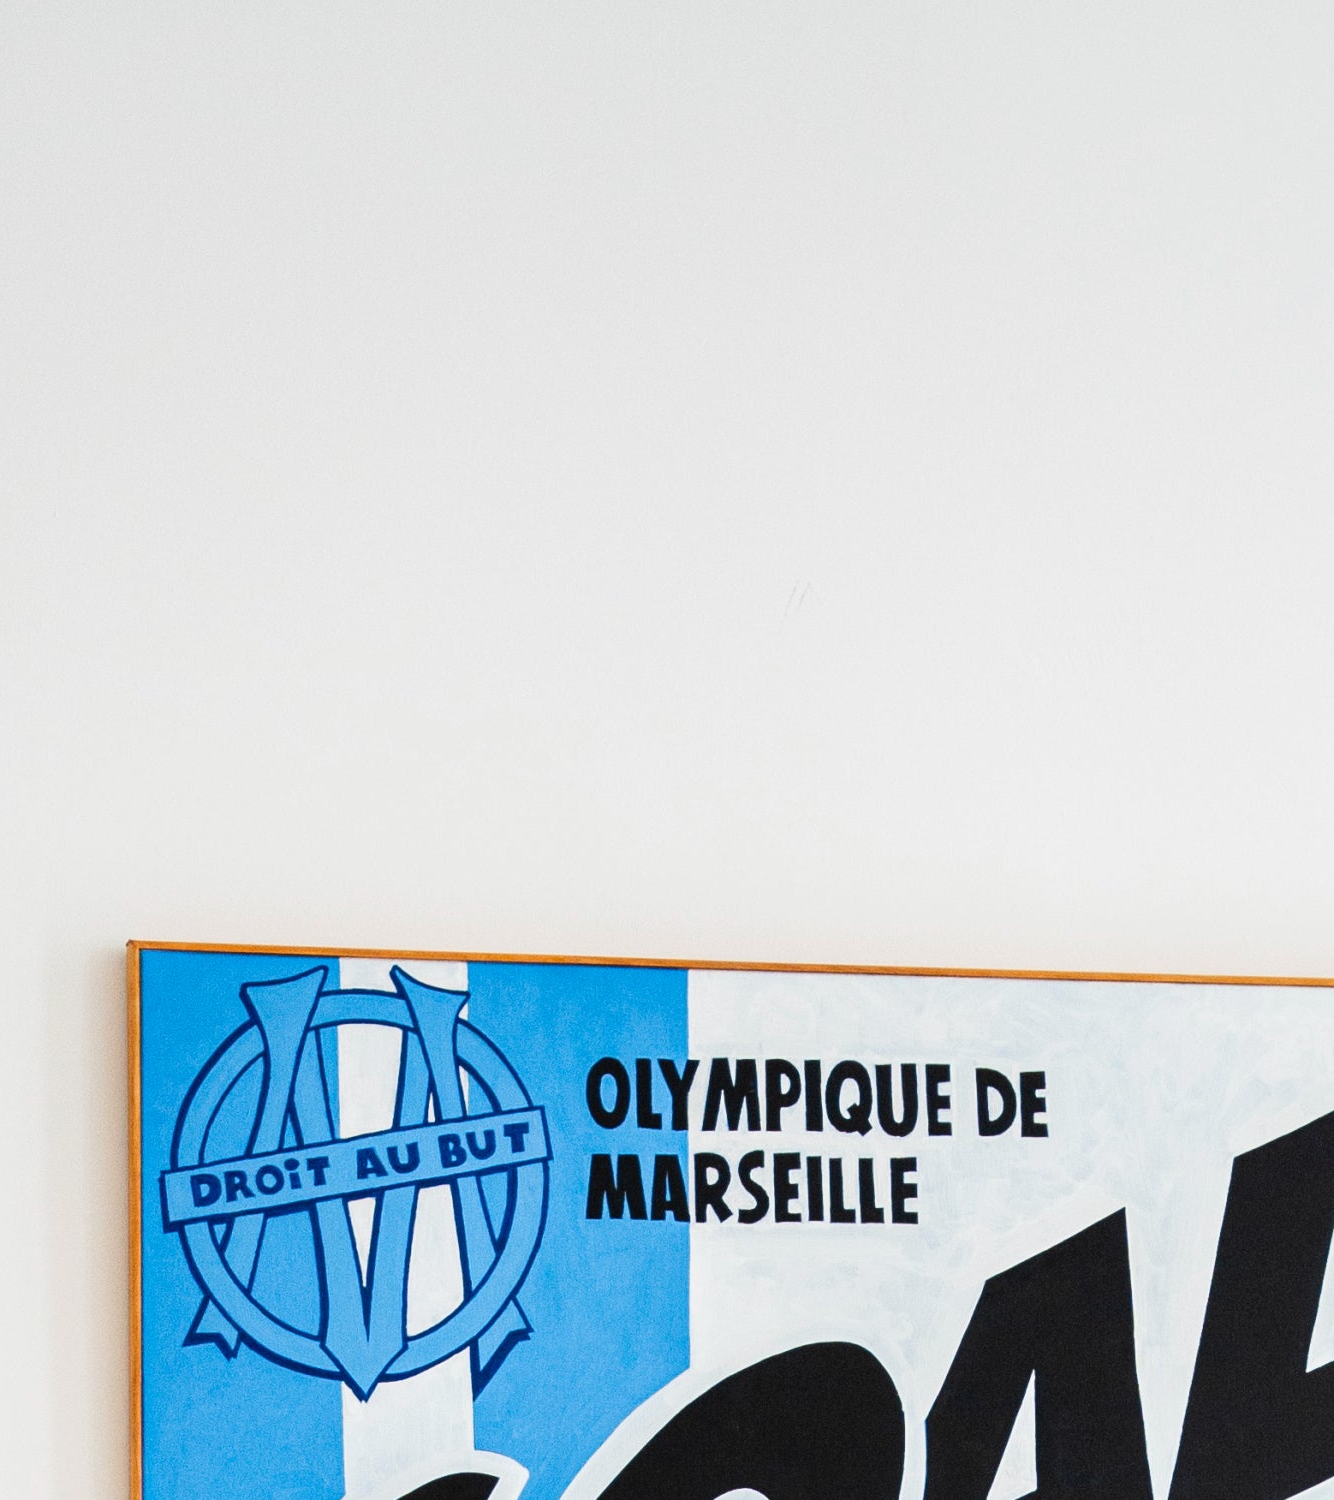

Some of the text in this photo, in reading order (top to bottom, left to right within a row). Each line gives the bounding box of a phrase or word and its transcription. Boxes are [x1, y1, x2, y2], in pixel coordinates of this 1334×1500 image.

[586, 1057, 1049, 1138] OLYMPIQUE DE
[357, 1142, 420, 1179] AU
[438, 1122, 529, 1169] BUT
[586, 1151, 919, 1225] MARSEILLE
